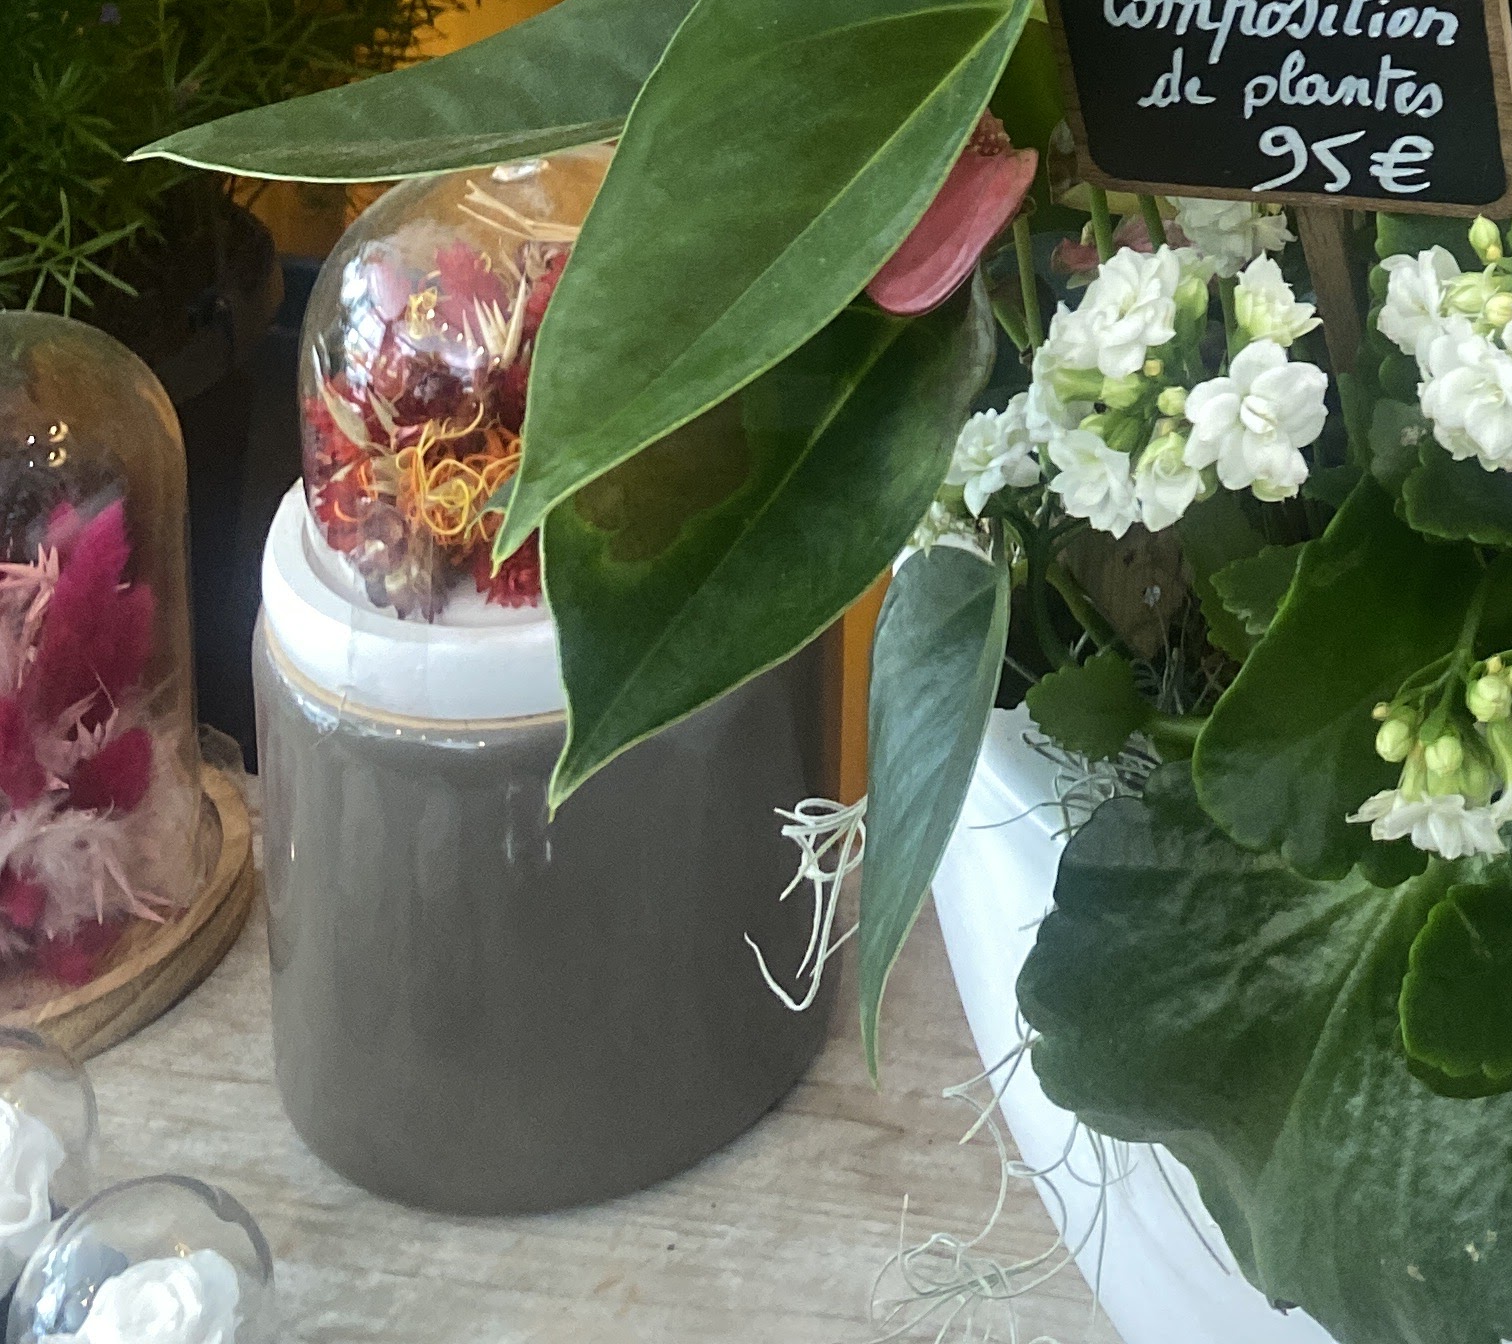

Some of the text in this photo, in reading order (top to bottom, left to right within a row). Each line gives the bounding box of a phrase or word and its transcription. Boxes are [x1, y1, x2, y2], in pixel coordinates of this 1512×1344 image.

[1137, 47, 1444, 120] de plantes
[1252, 125, 1436, 194] 95€
